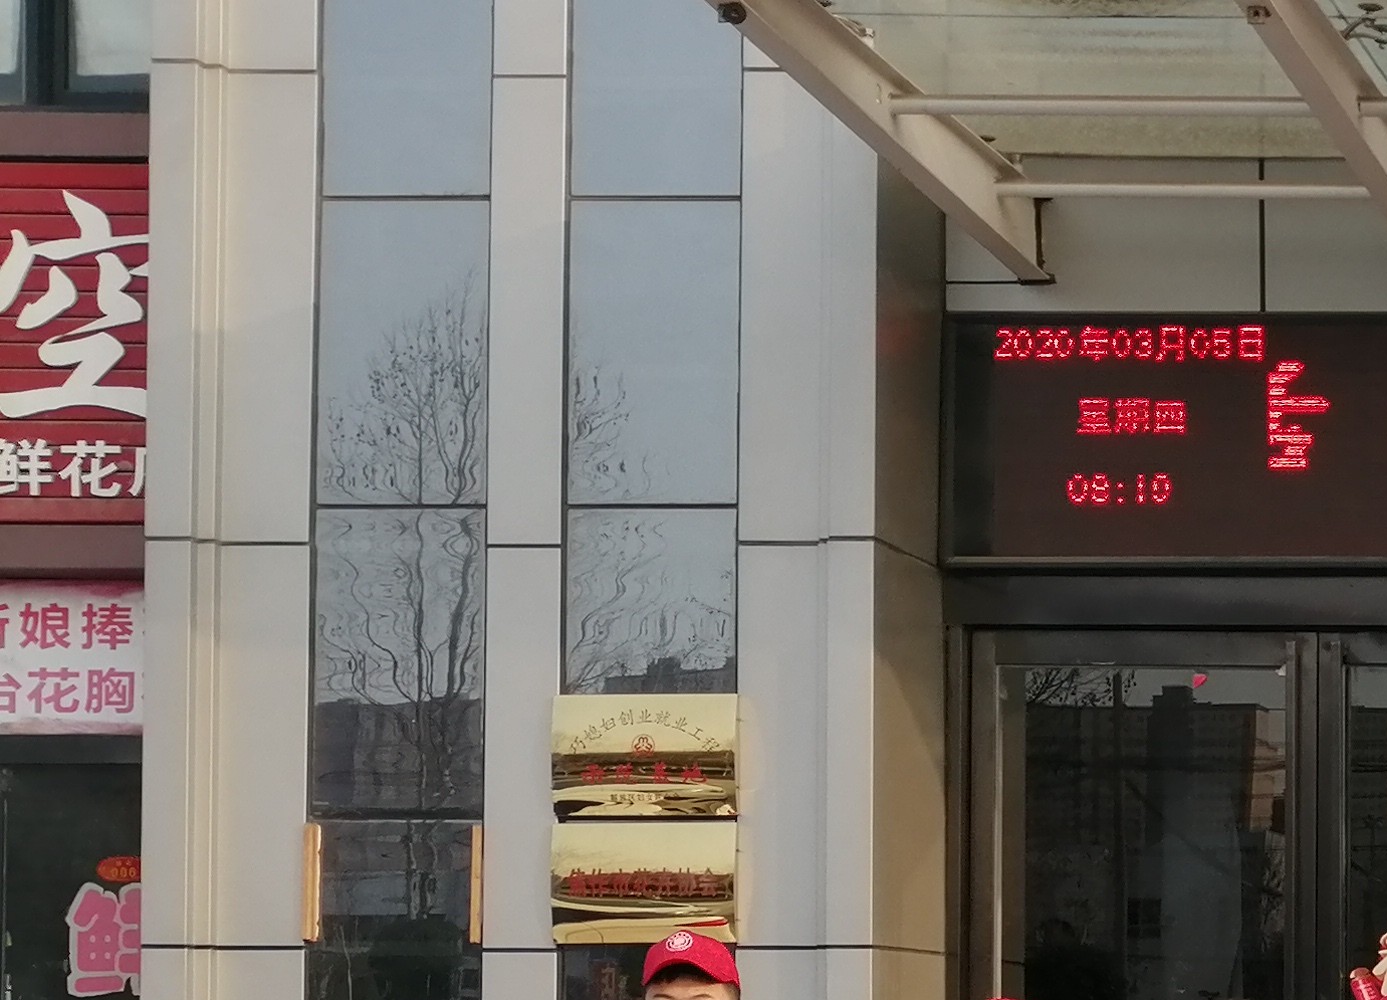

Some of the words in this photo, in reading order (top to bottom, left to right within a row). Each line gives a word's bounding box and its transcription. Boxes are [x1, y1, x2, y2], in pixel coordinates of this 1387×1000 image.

[993, 324, 1265, 364] 2020年03月05日
[1077, 397, 1185, 436] 星期四
[0, 438, 146, 498] 鲜花
[568, 709, 724, 753] 巧媳妇创业就业工程
